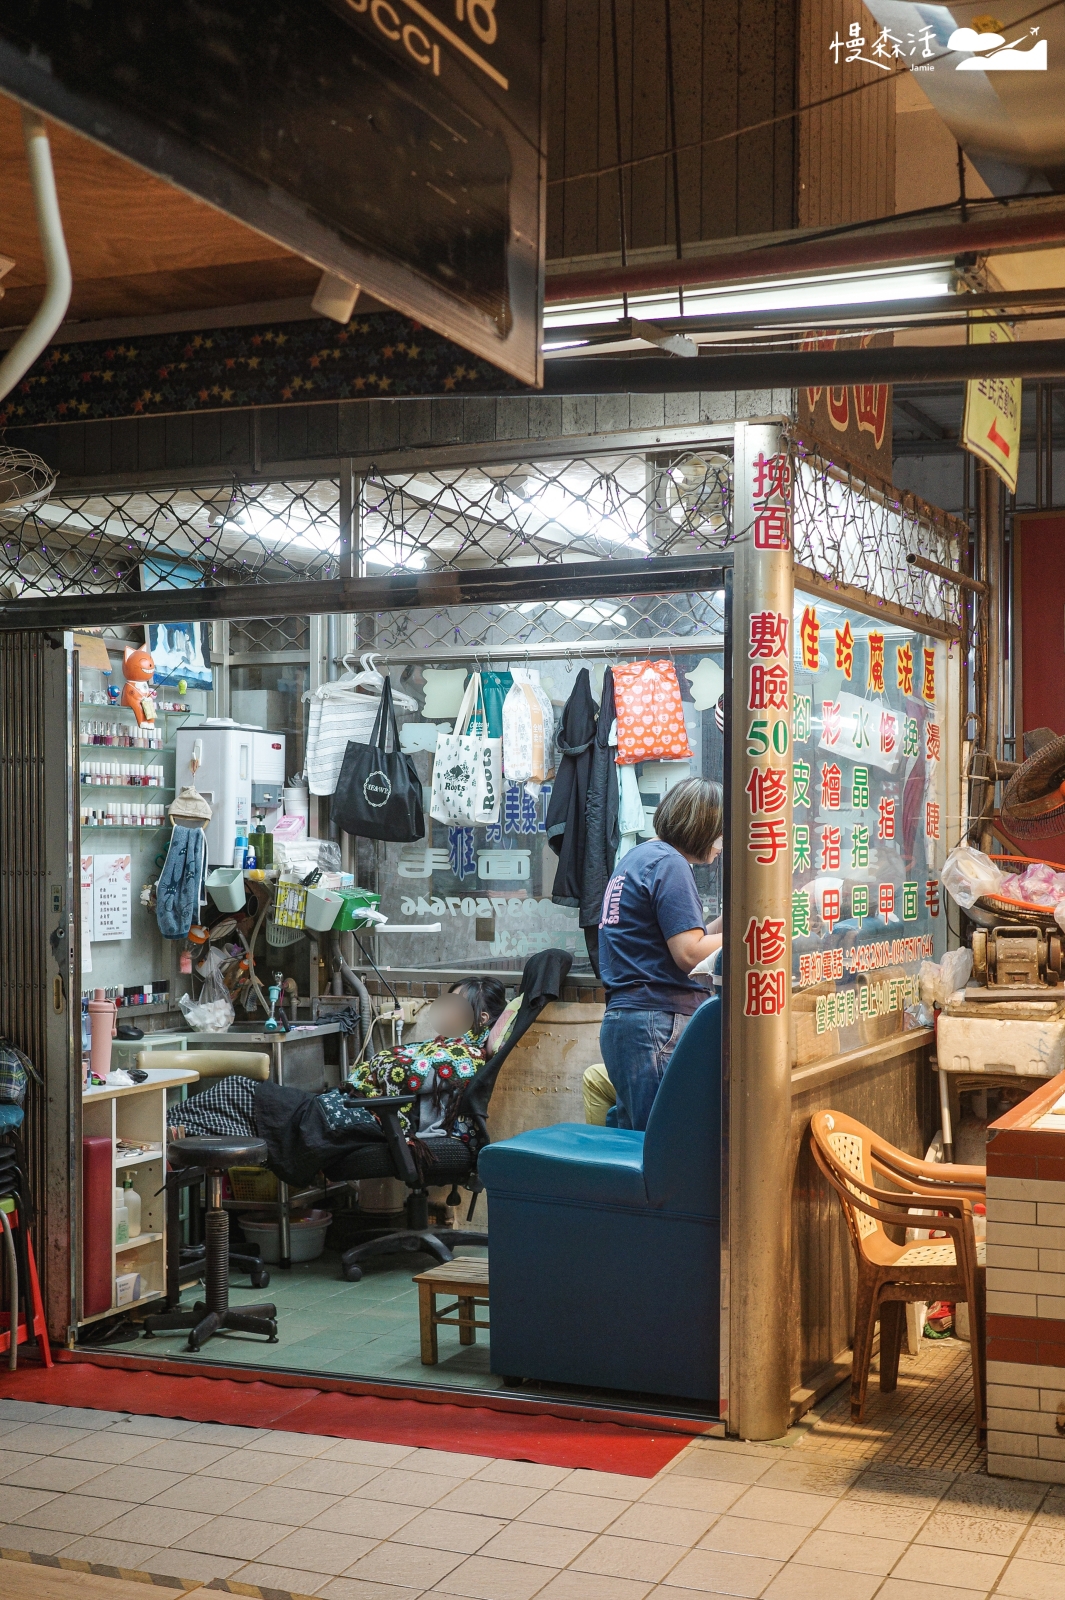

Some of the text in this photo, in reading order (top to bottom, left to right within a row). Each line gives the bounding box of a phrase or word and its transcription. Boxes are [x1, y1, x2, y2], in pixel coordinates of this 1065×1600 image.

[752, 452, 791, 552] 挽面
[800, 604, 936, 702] 佳玲魔法屋
[444, 782, 466, 792] Roots
[821, 700, 842, 933] 彩繪指甲
[851, 705, 870, 929] 水晶指甲
[878, 711, 896, 925] 修指甲
[903, 717, 919, 921] 挽面
[926, 721, 941, 918] 燙睫毛
[743, 916, 787, 1018] 修腳
